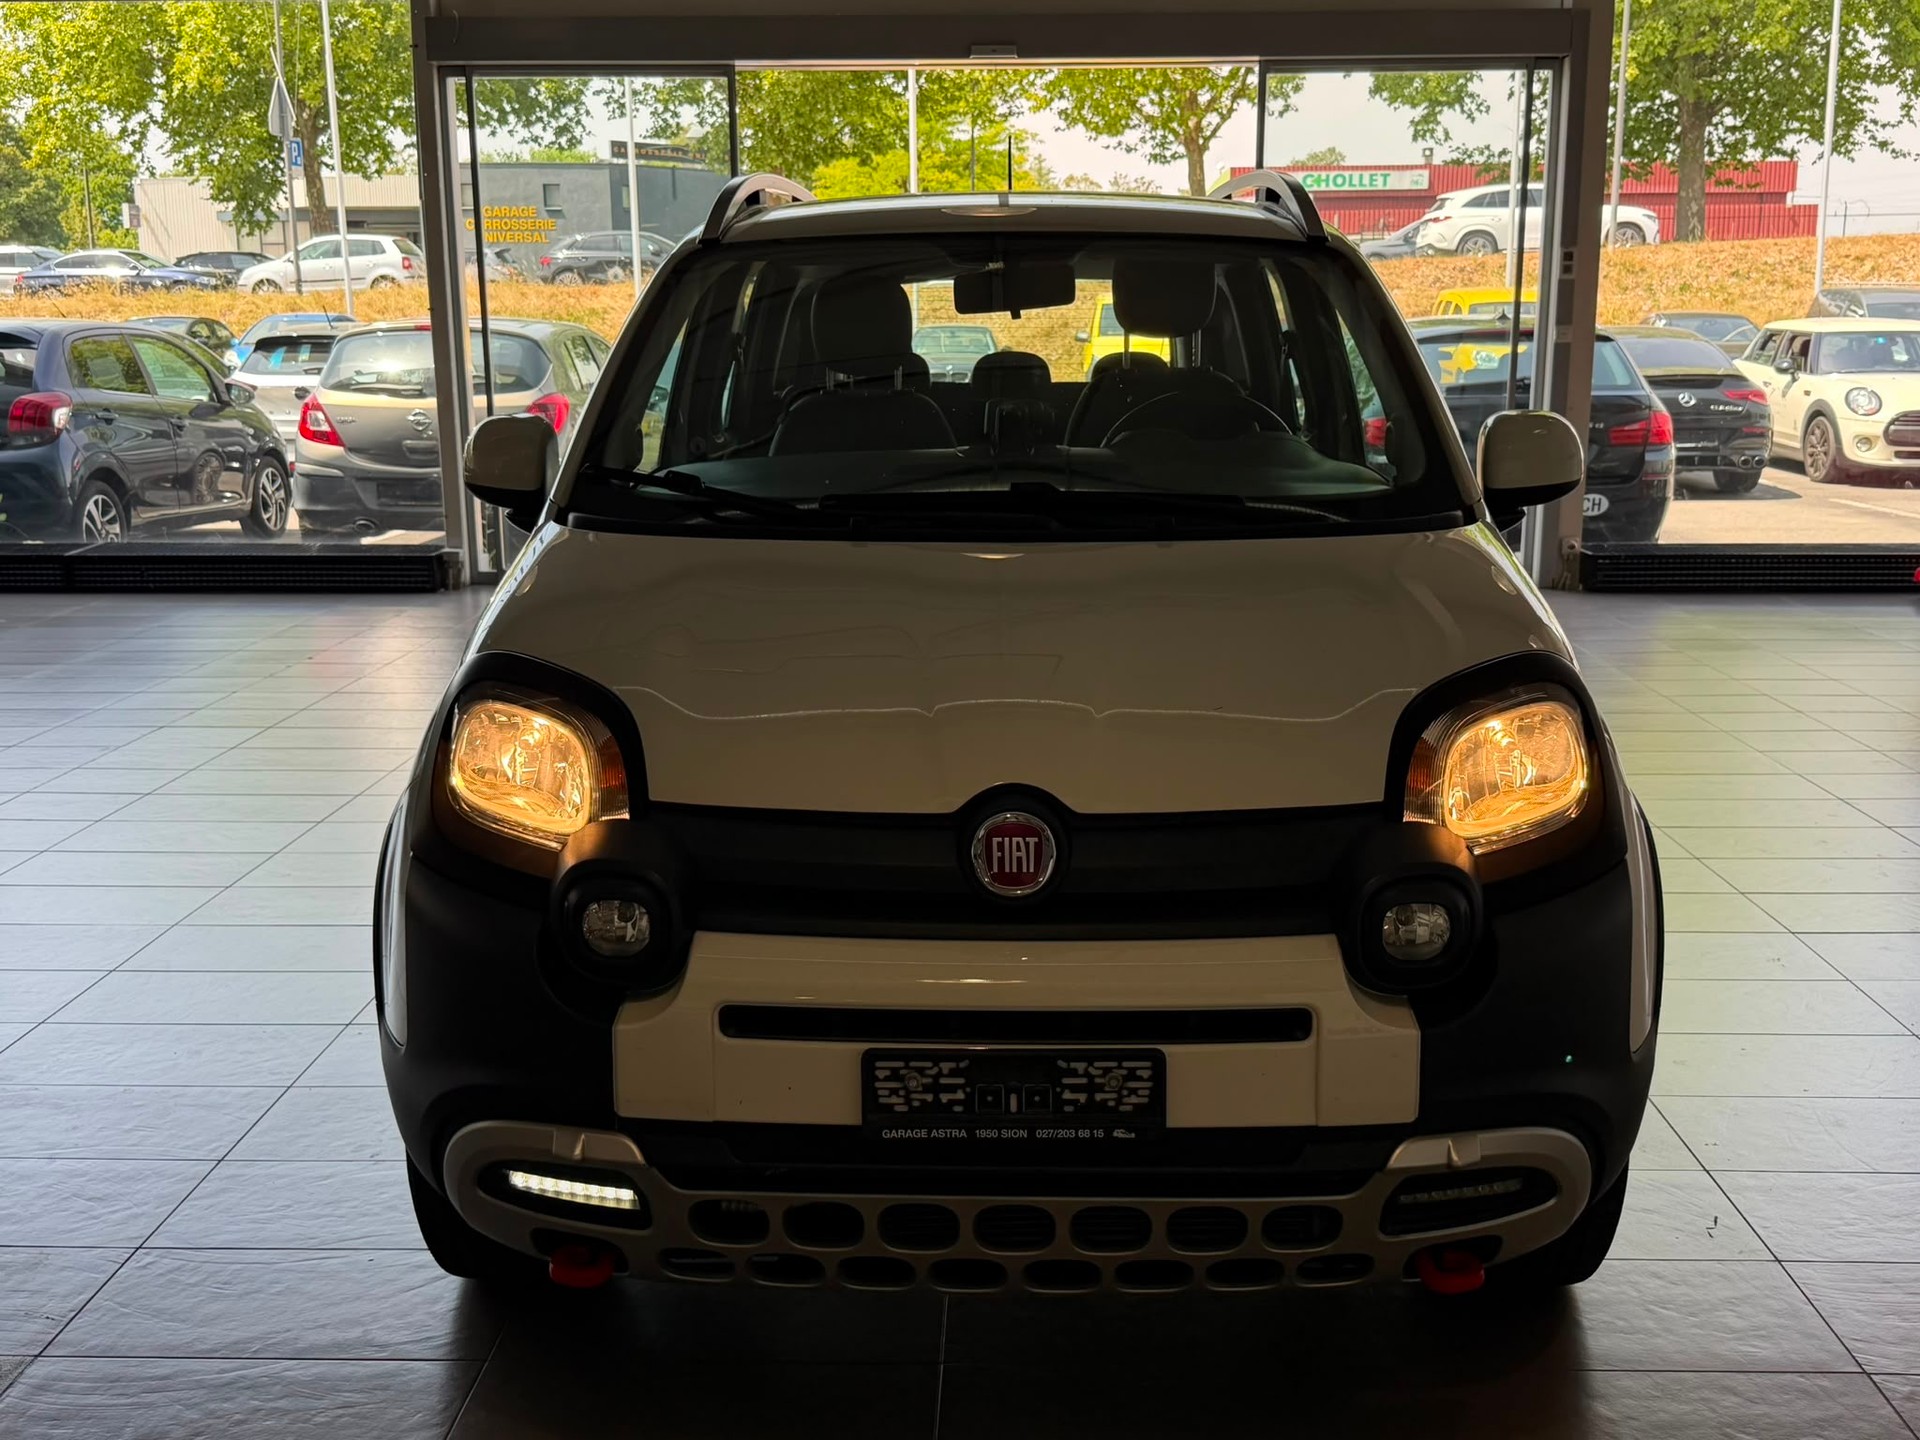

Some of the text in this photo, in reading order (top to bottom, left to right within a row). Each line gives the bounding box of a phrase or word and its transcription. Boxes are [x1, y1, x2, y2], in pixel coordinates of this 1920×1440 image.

[1302, 172, 1391, 188] CHOLLET
[482, 205, 538, 218] GARAGE
[465, 218, 557, 231] CRROSSERIE
[484, 231, 550, 244] NIVERSAL
[1583, 497, 1602, 512] CH
[992, 837, 1039, 873] FIAT
[882, 1129, 1105, 1139] GARAGE ASTRA 1950 SION 027/203 68 15
